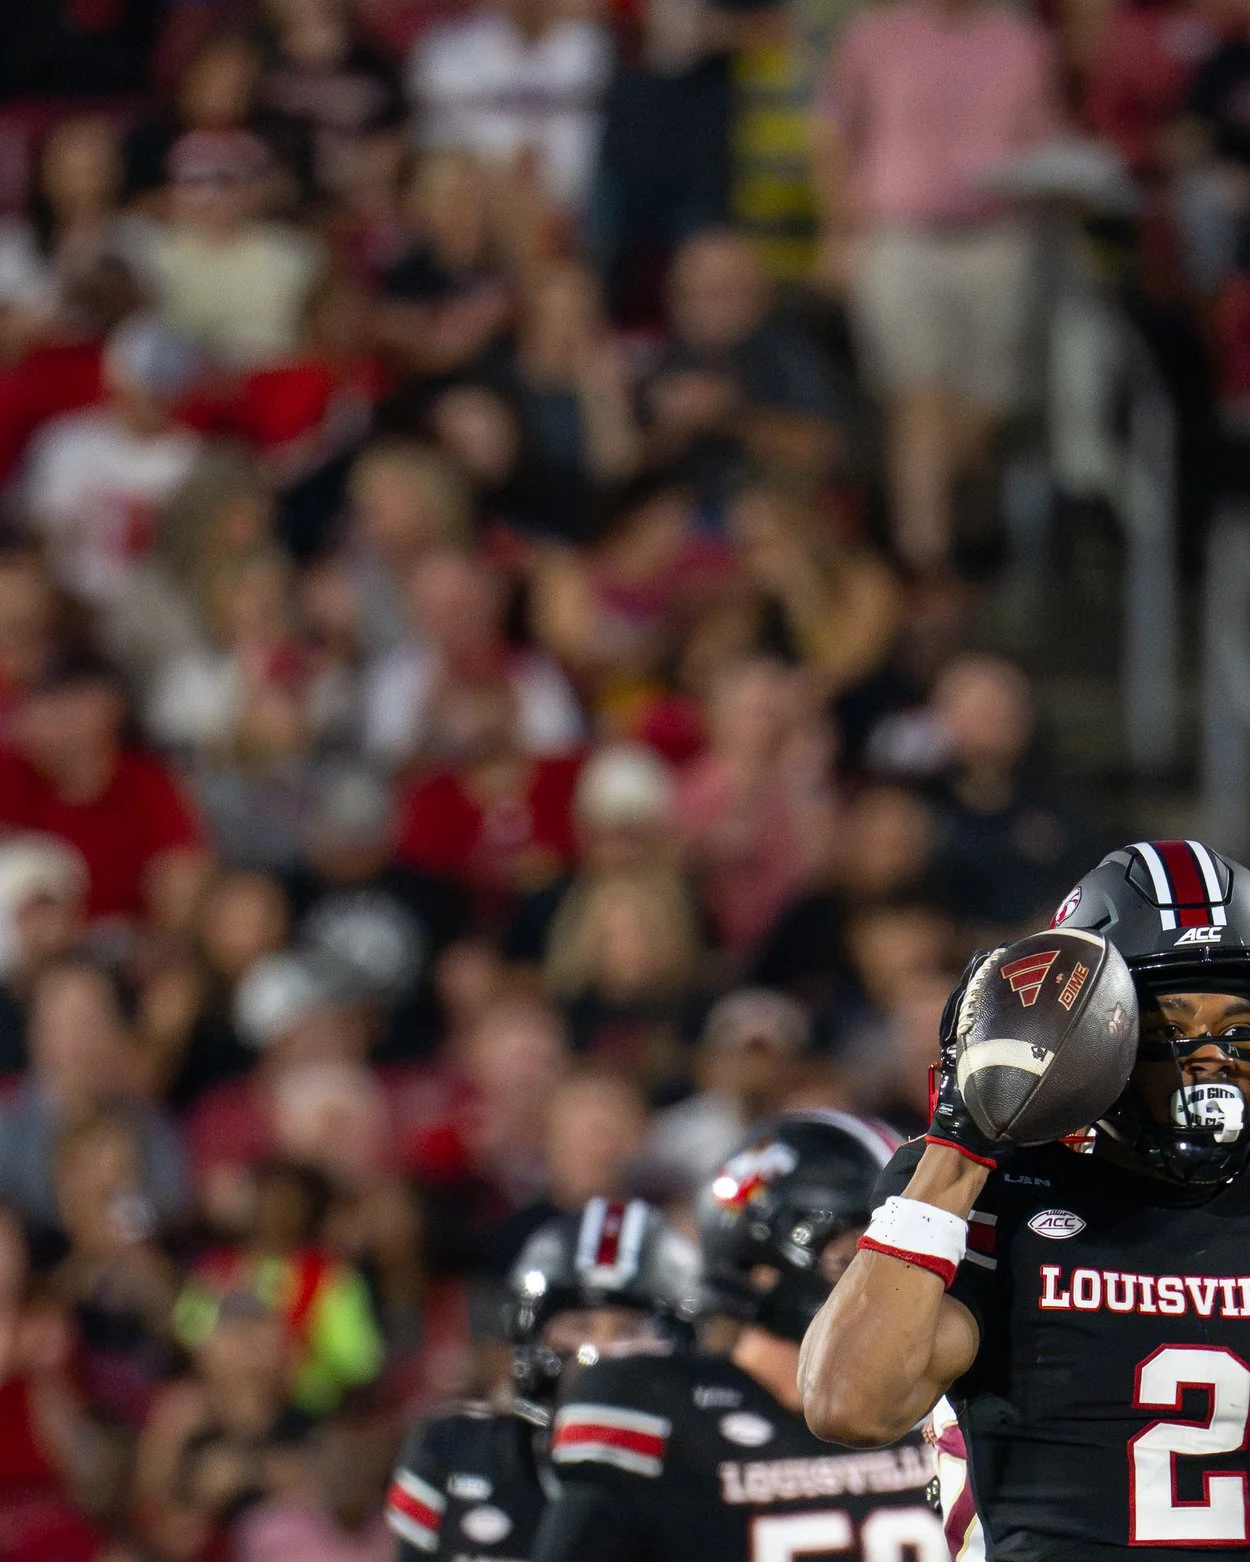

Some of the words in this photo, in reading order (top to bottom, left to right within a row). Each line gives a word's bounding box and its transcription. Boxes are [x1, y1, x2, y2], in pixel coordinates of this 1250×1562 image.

[1174, 926, 1223, 946] ACC
[1058, 961, 1089, 1011] DIME
[1038, 1217, 1077, 1228] ACC
